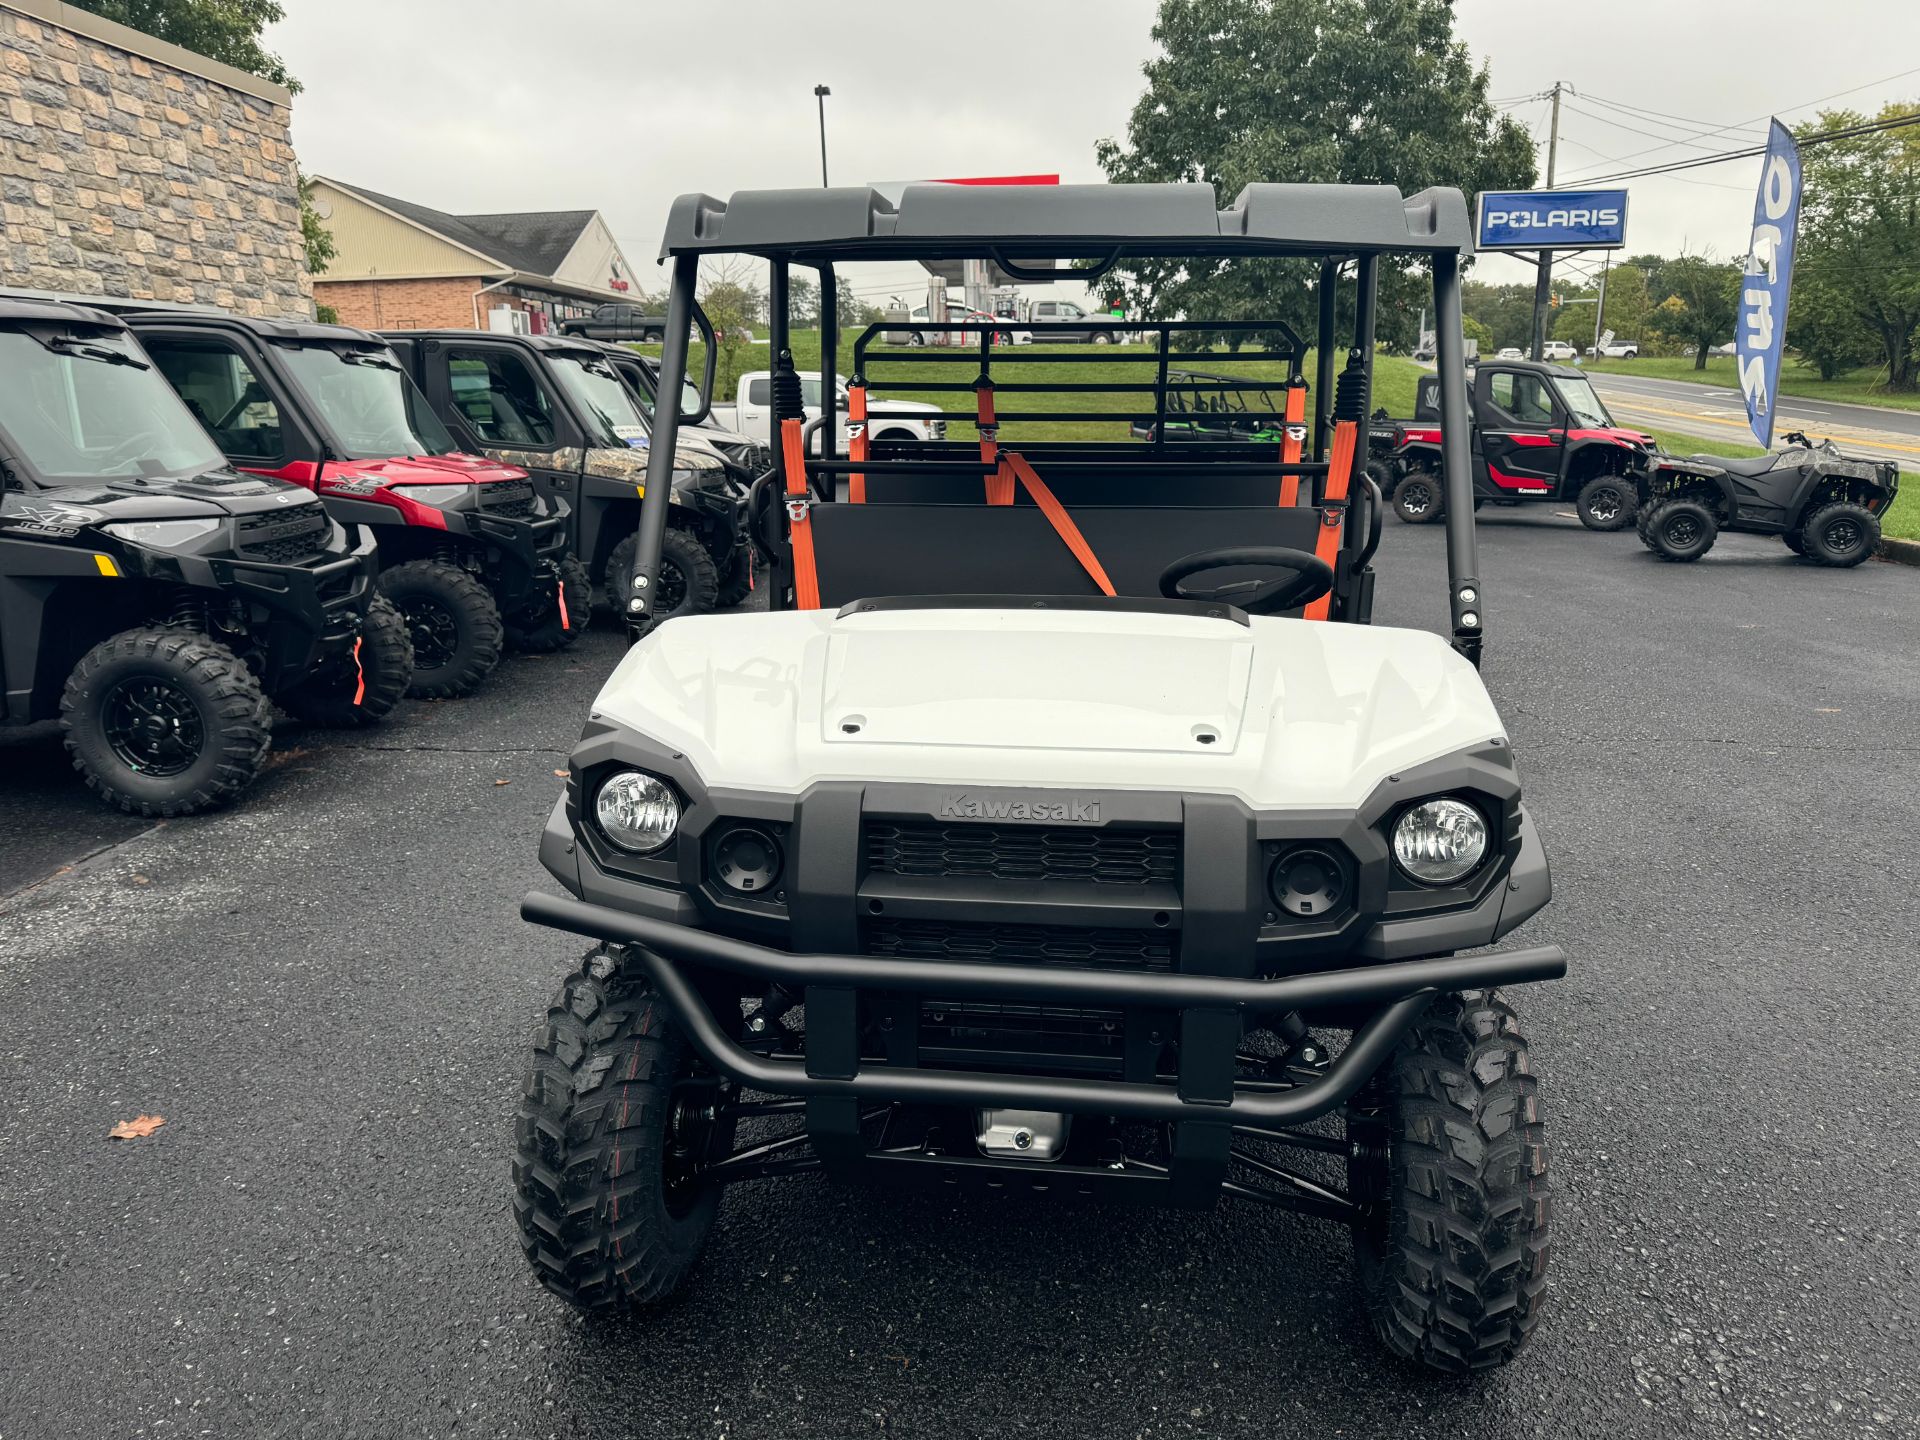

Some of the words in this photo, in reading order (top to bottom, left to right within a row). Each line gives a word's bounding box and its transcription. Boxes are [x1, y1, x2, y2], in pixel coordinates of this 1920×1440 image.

[1487, 209, 1619, 228] POLARIS
[327, 473, 386, 487] XP
[334, 484, 376, 495] 1000
[5, 506, 95, 525] XP
[20, 521, 80, 536] 1000
[941, 792, 1101, 822] Kawasaki
